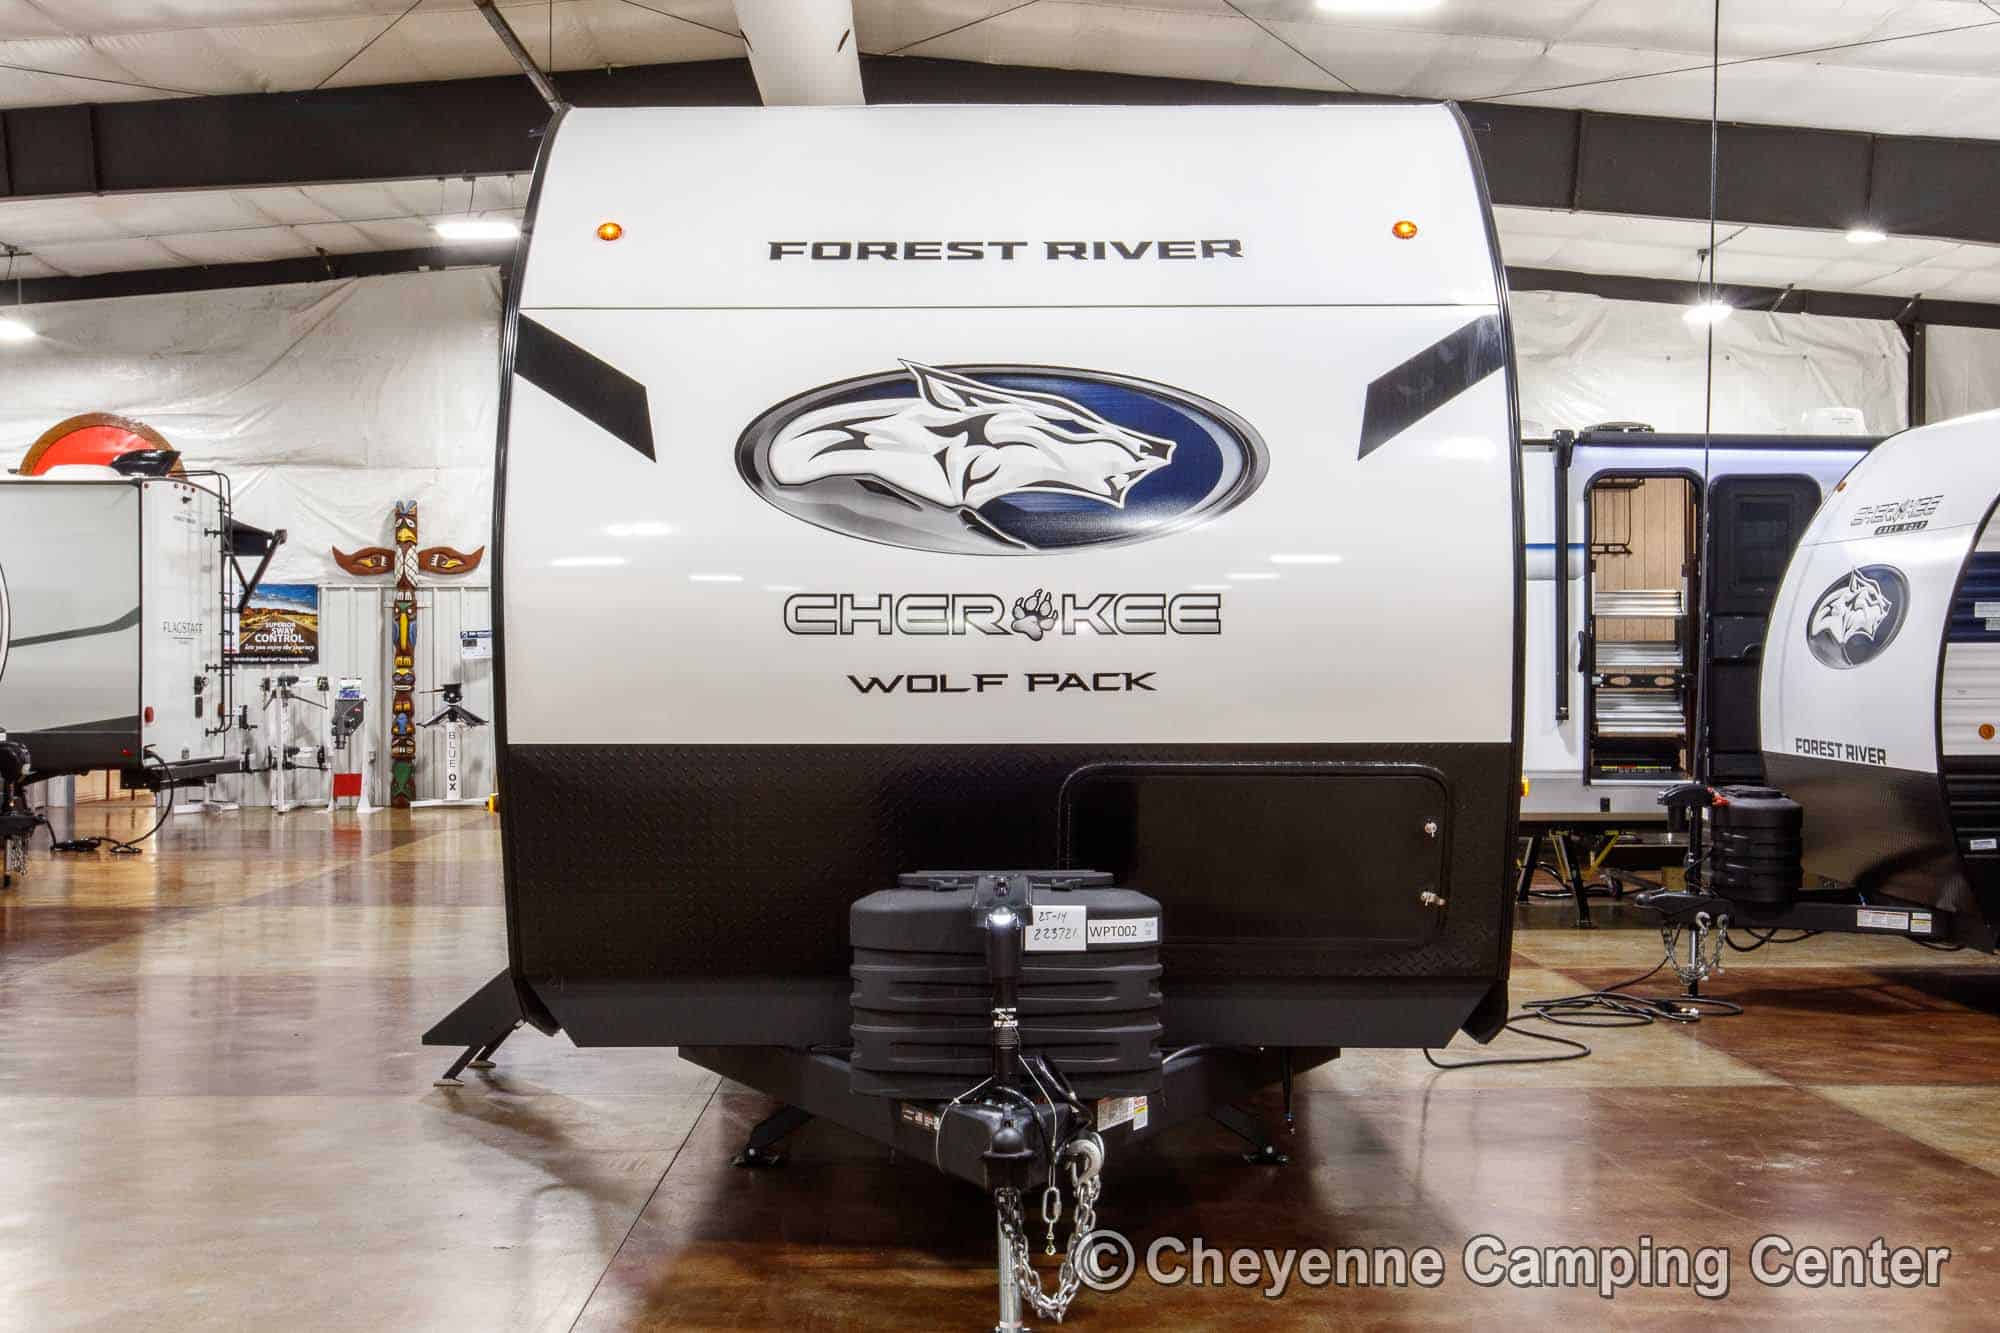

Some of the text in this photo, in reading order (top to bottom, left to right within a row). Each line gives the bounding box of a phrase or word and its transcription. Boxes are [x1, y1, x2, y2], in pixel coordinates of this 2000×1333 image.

[767, 239, 1245, 261] FOREST RIVER
[254, 634, 304, 643] CONTROL
[846, 672, 1158, 693] WOLF PACK
[1795, 738, 1887, 765] FOREST RIVER
[448, 773, 457, 791] OX
[1088, 924, 1137, 937] WPT002
